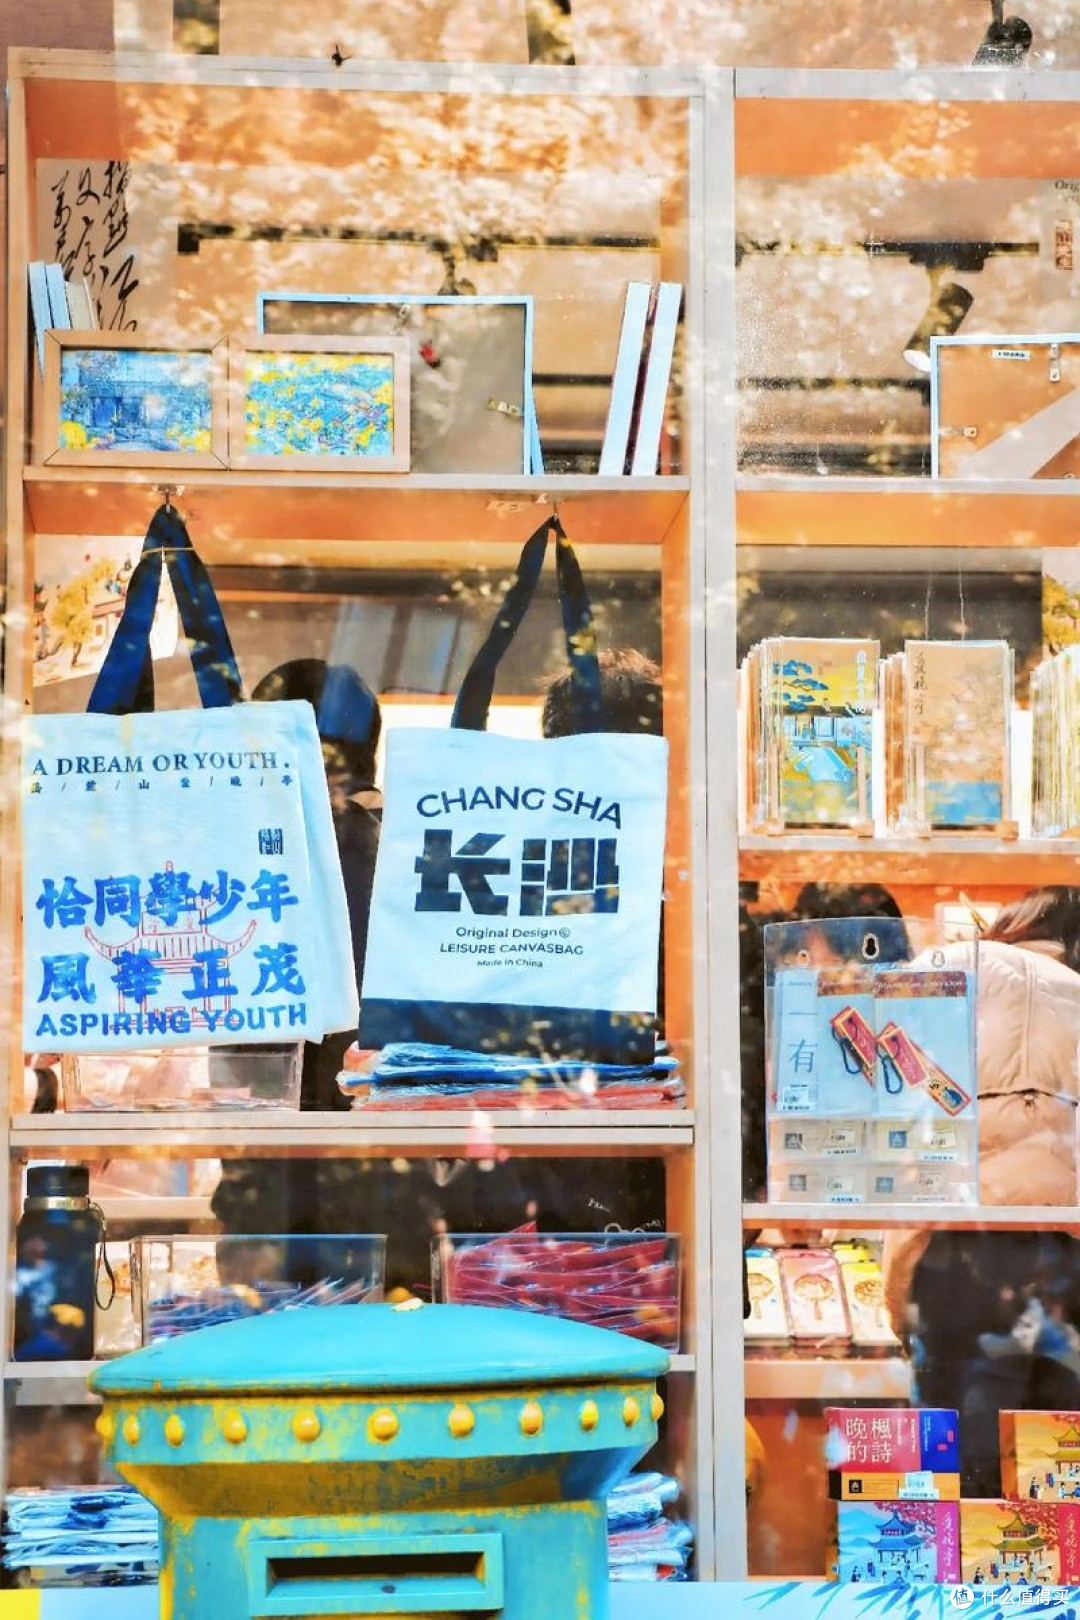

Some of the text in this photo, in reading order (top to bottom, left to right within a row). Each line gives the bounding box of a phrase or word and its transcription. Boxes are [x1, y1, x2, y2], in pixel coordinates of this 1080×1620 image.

[33, 759, 48, 775] A
[56, 755, 143, 775] DREAM
[416, 786, 622, 829] CHANG SHA
[36, 869, 298, 928] 恰同學少年
[456, 926, 508, 940] Original
[440, 942, 584, 955] LEISURE CANVASBAG
[37, 942, 306, 1004] 風華正茂
[477, 958, 502, 967] Made
[515, 958, 544, 968] China
[36, 1003, 307, 1037] ASPIRING YOUTH
